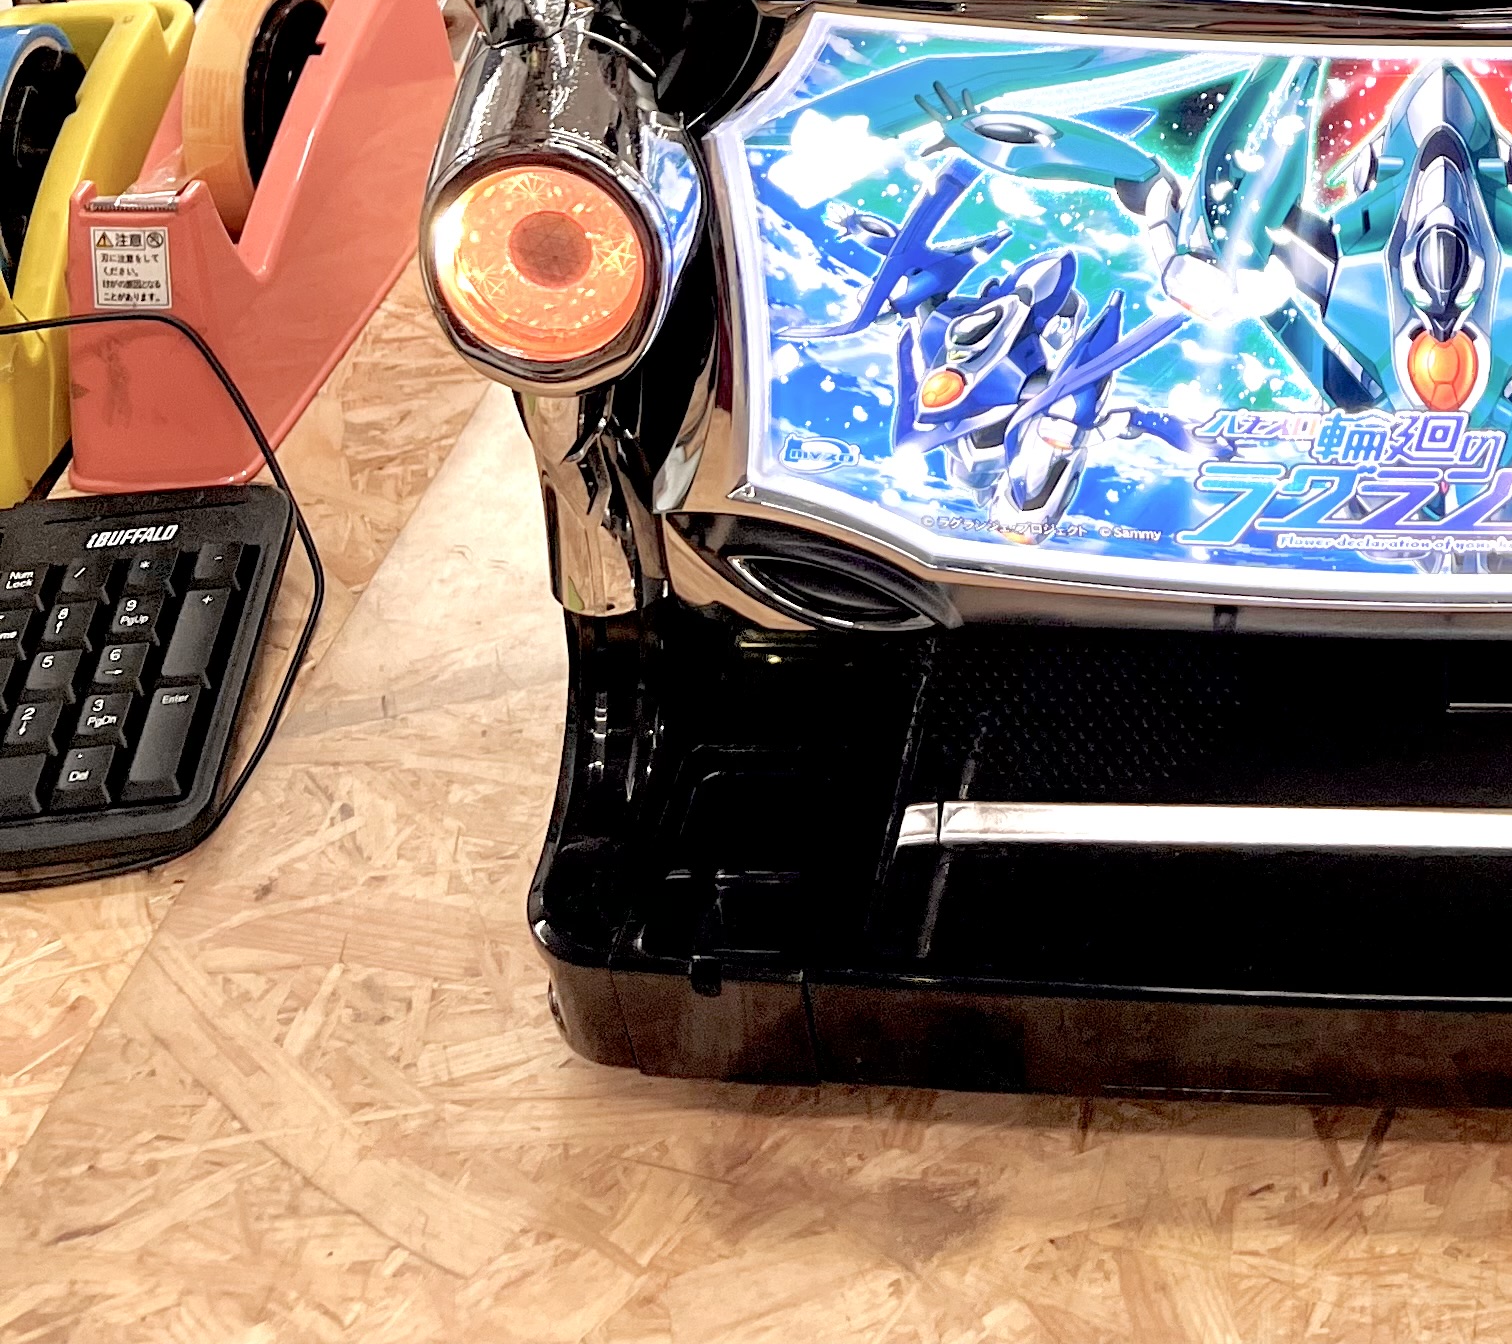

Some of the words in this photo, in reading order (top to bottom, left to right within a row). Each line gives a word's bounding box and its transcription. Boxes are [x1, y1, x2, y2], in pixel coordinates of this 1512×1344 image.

[115, 232, 142, 247] 注意
[1316, 413, 1505, 465] 輪廻の
[9, 571, 34, 580] Num
[6, 579, 33, 590] Lock
[125, 599, 137, 612] 9
[119, 615, 149, 627] PgUp
[109, 648, 122, 661] 6
[41, 656, 54, 668] 5
[92, 699, 104, 712] 3
[161, 693, 190, 705] Enter
[21, 707, 36, 721] 2
[86, 714, 117, 729] PgDn
[68, 770, 90, 782] Del
